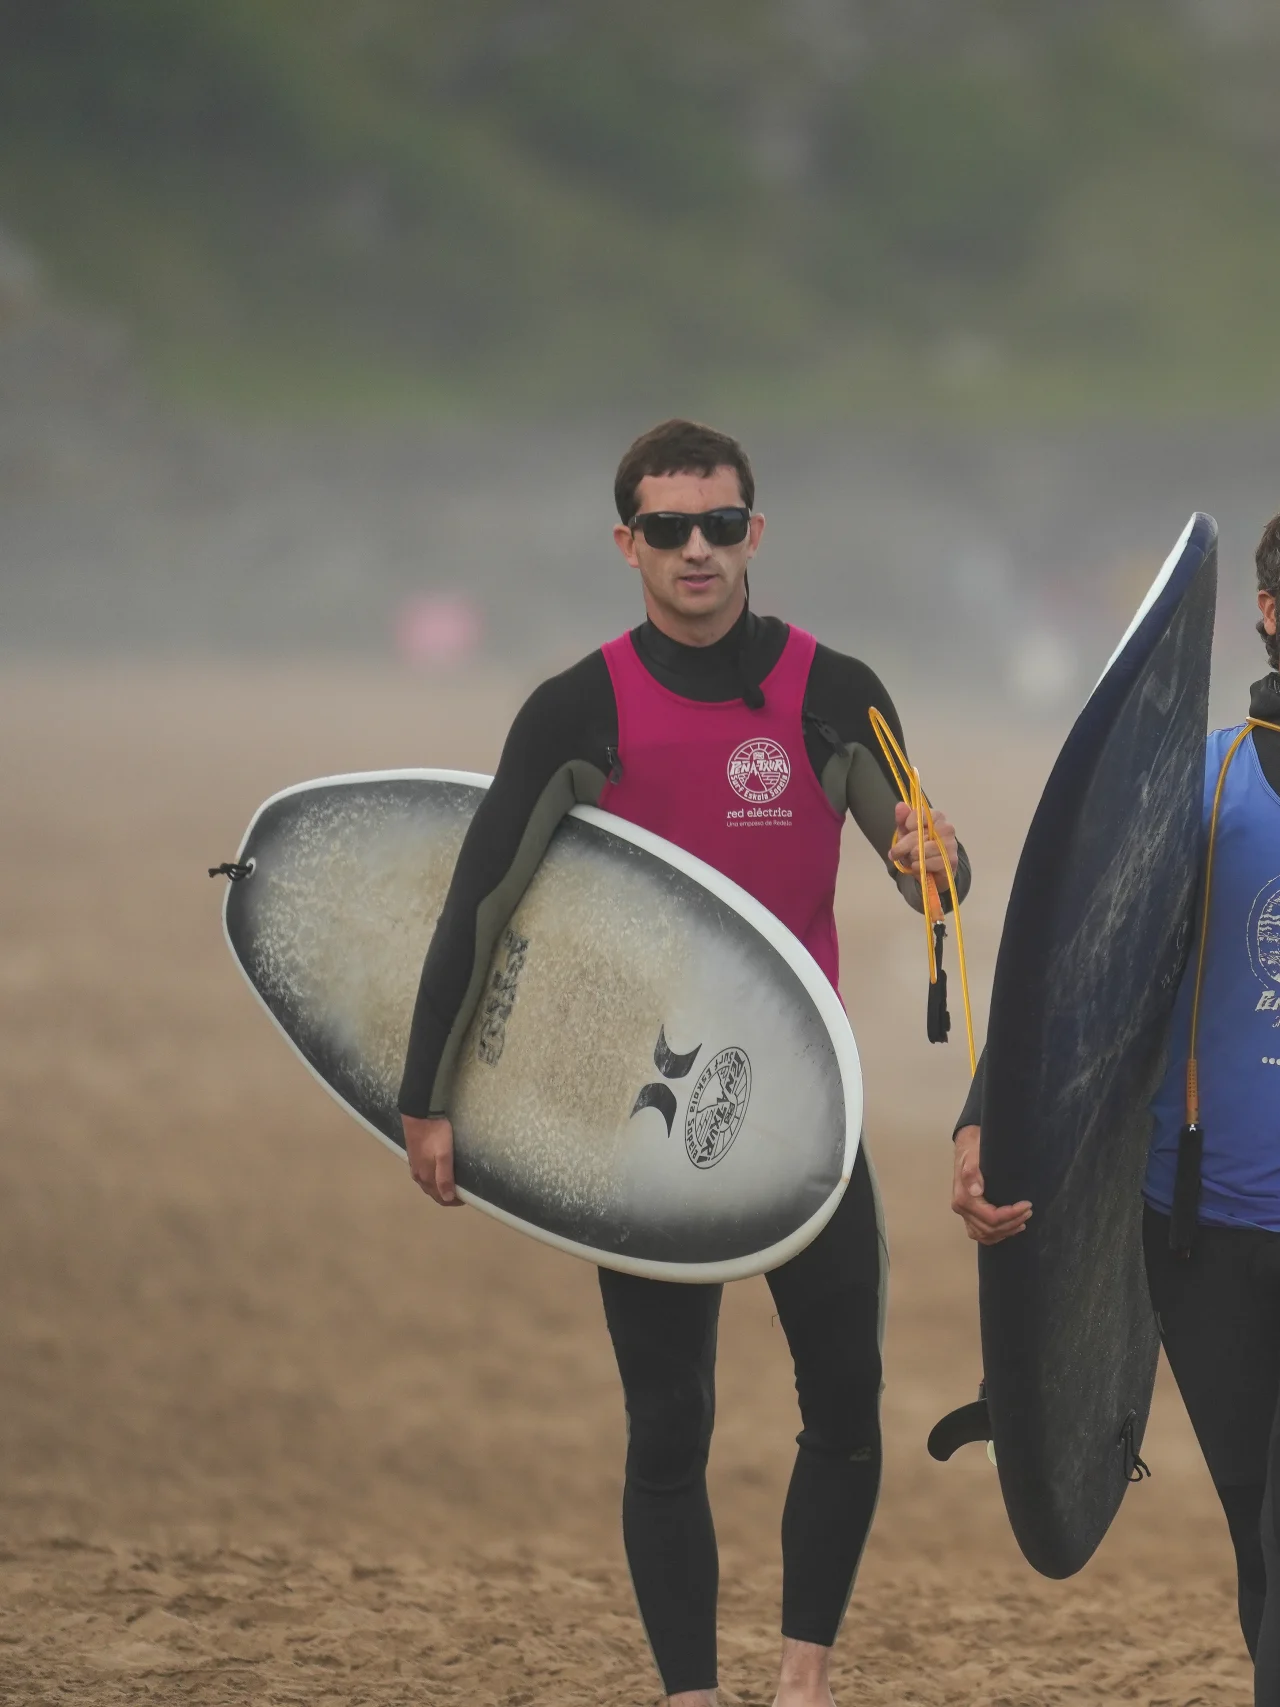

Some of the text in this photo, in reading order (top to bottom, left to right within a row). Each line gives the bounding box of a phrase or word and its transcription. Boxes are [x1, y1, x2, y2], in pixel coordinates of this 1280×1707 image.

[726, 807, 793, 819] red eléctrica
[690, 1068, 712, 1112] Eskola
